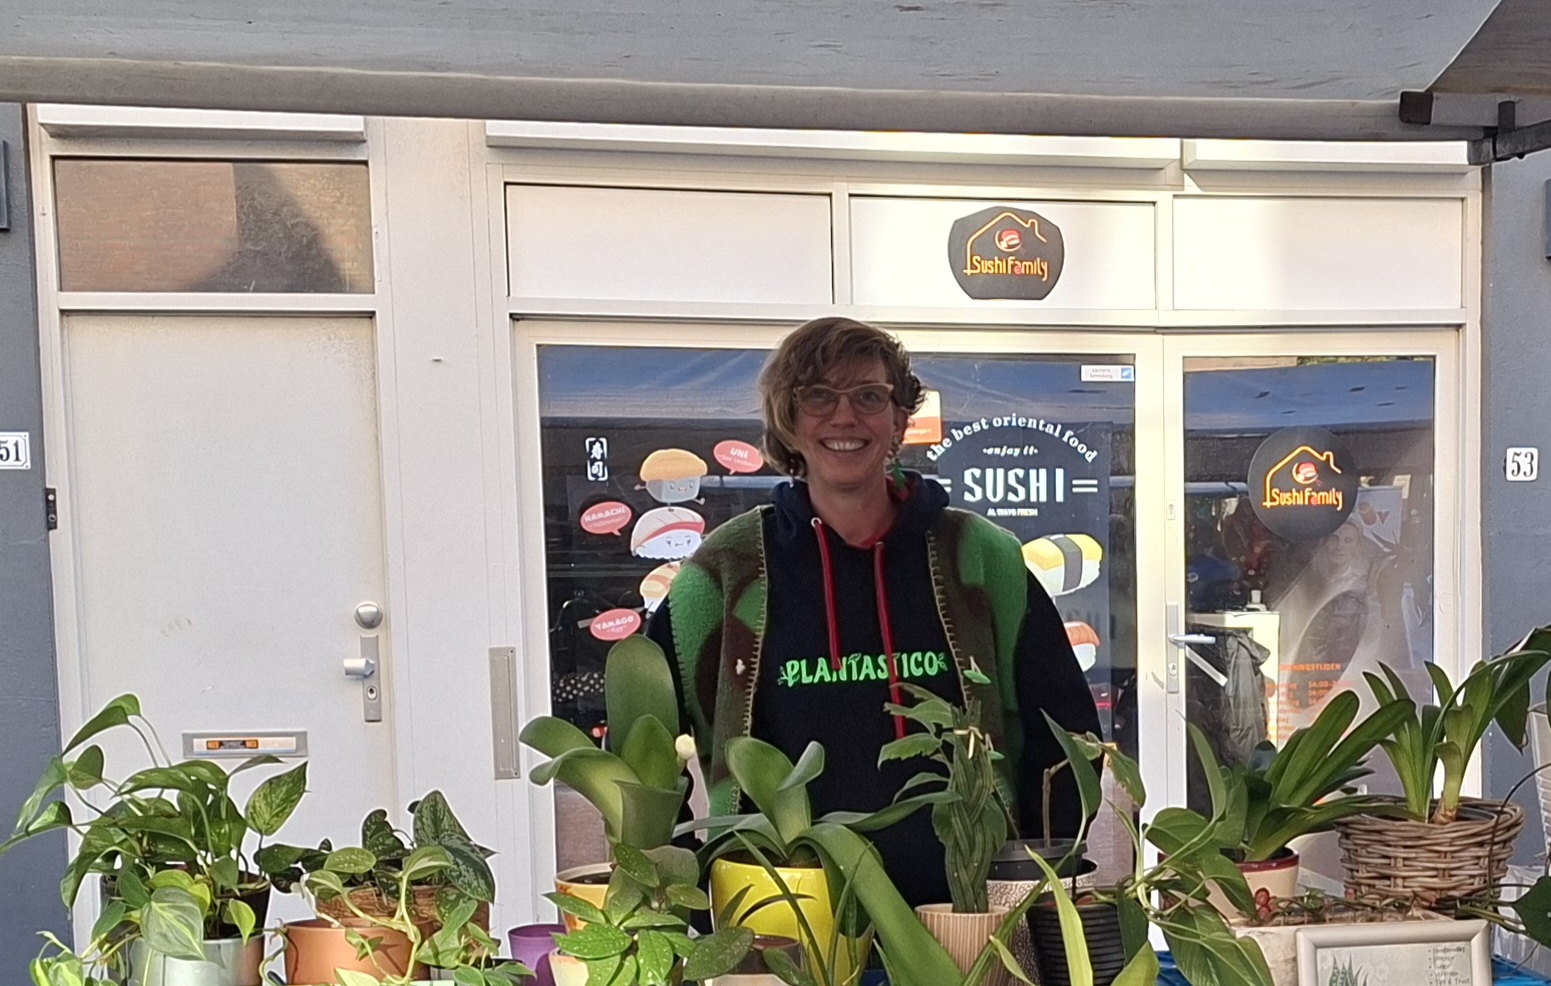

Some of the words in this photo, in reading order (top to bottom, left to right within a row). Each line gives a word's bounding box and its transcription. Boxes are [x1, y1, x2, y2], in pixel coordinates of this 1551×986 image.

[926, 437, 953, 462] the
[950, 416, 990, 442] best
[992, 412, 1063, 438] oriental
[1061, 430, 1098, 463] food
[0, 439, 22, 462] 51
[730, 447, 749, 459] UNI
[1511, 451, 1535, 477] 53
[963, 467, 1065, 503] SUSHI
[584, 506, 626, 523] HAMACHI
[595, 614, 634, 631] TAMAGO
